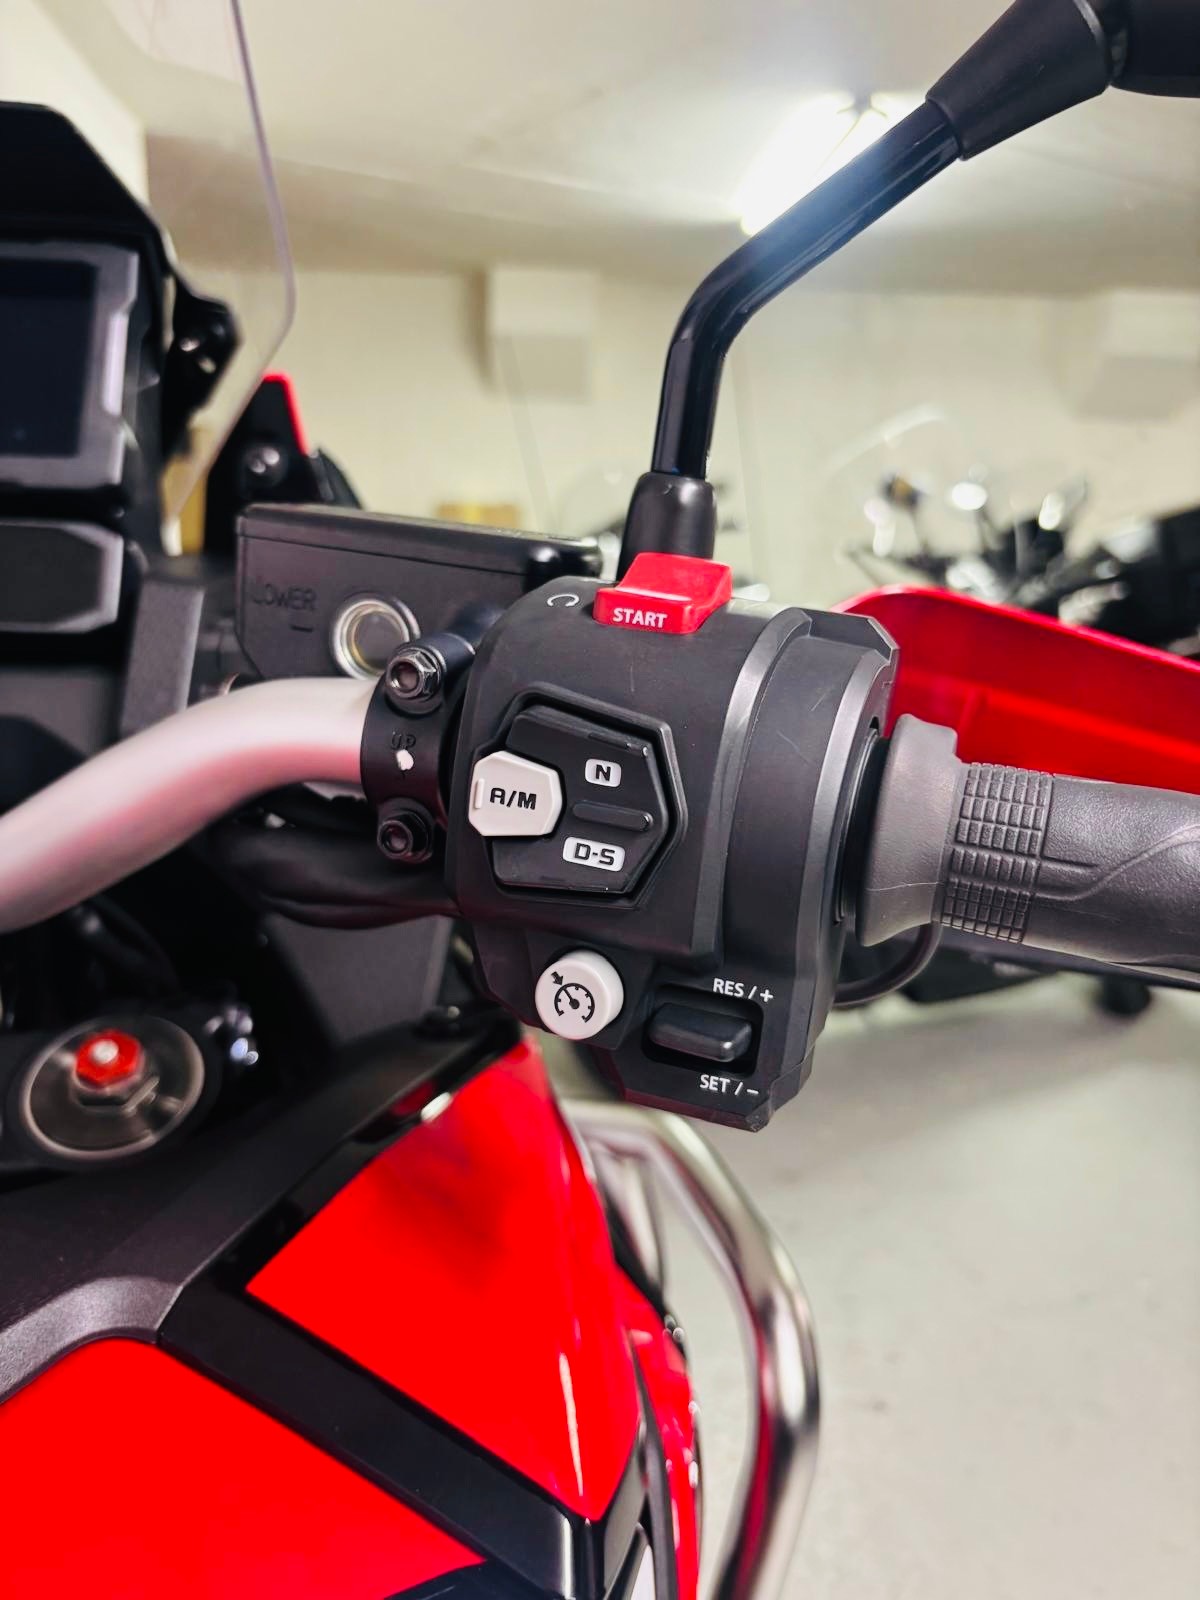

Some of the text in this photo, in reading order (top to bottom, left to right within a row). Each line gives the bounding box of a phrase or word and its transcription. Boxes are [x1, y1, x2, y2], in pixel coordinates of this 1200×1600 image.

[612, 607, 668, 629] START
[595, 764, 612, 782] N
[489, 787, 537, 810] A/M
[574, 842, 616, 867] D-S
